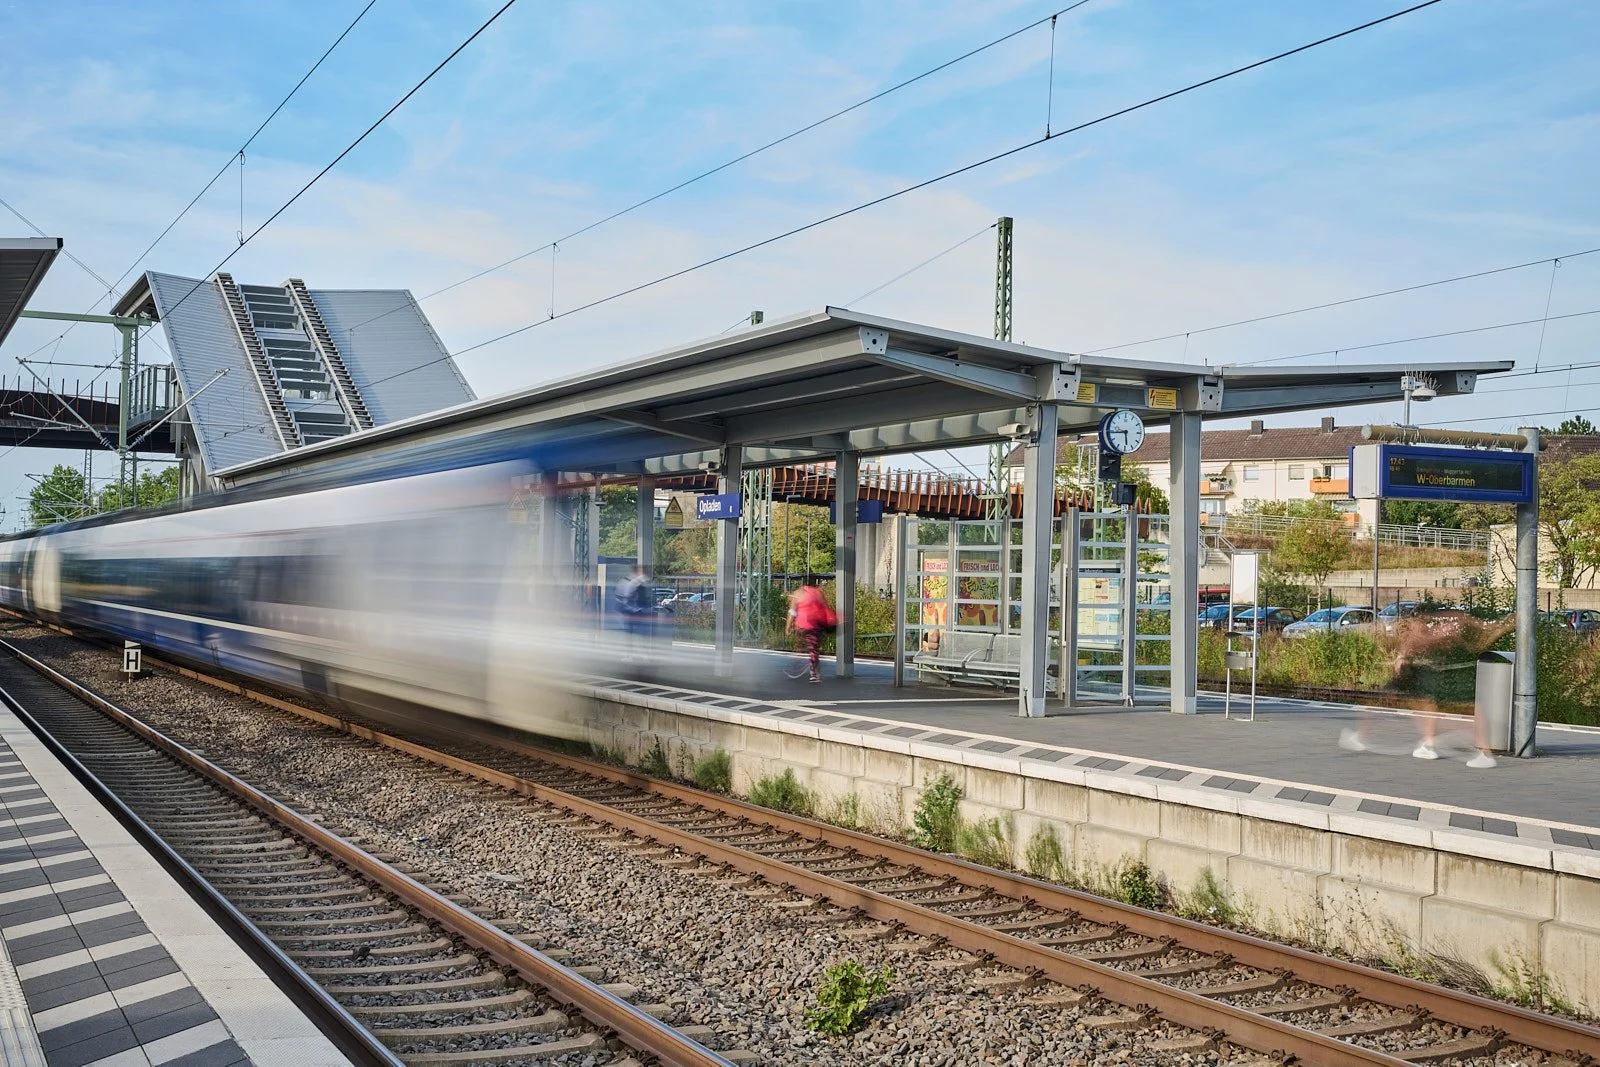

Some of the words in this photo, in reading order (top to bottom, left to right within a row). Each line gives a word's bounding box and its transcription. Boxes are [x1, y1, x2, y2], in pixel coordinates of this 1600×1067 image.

[1416, 473, 1476, 487] W-Oberbarmen
[700, 499, 721, 515] Opladen
[126, 651, 138, 670] H
